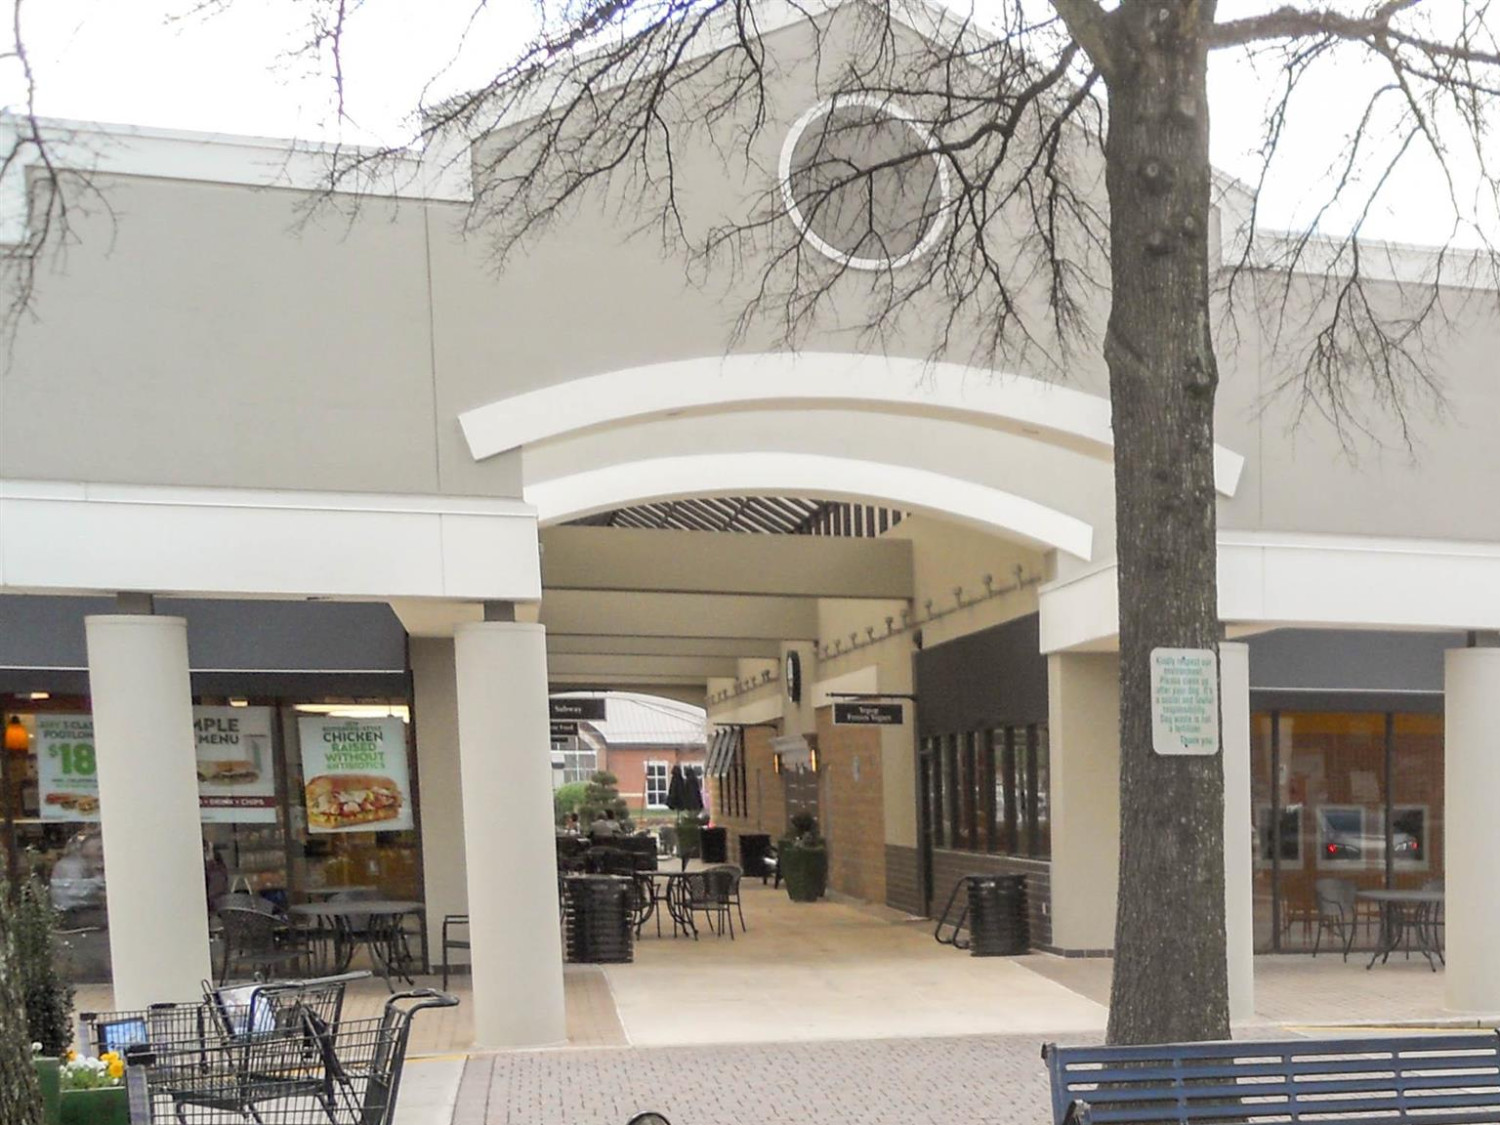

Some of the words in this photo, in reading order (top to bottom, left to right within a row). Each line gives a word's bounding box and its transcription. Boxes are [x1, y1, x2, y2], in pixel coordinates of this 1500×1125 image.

[199, 734, 240, 744] MENU
[323, 731, 383, 742] CHICKEN
[332, 742, 376, 752] RAISED
[325, 752, 385, 762] WITHOUT
